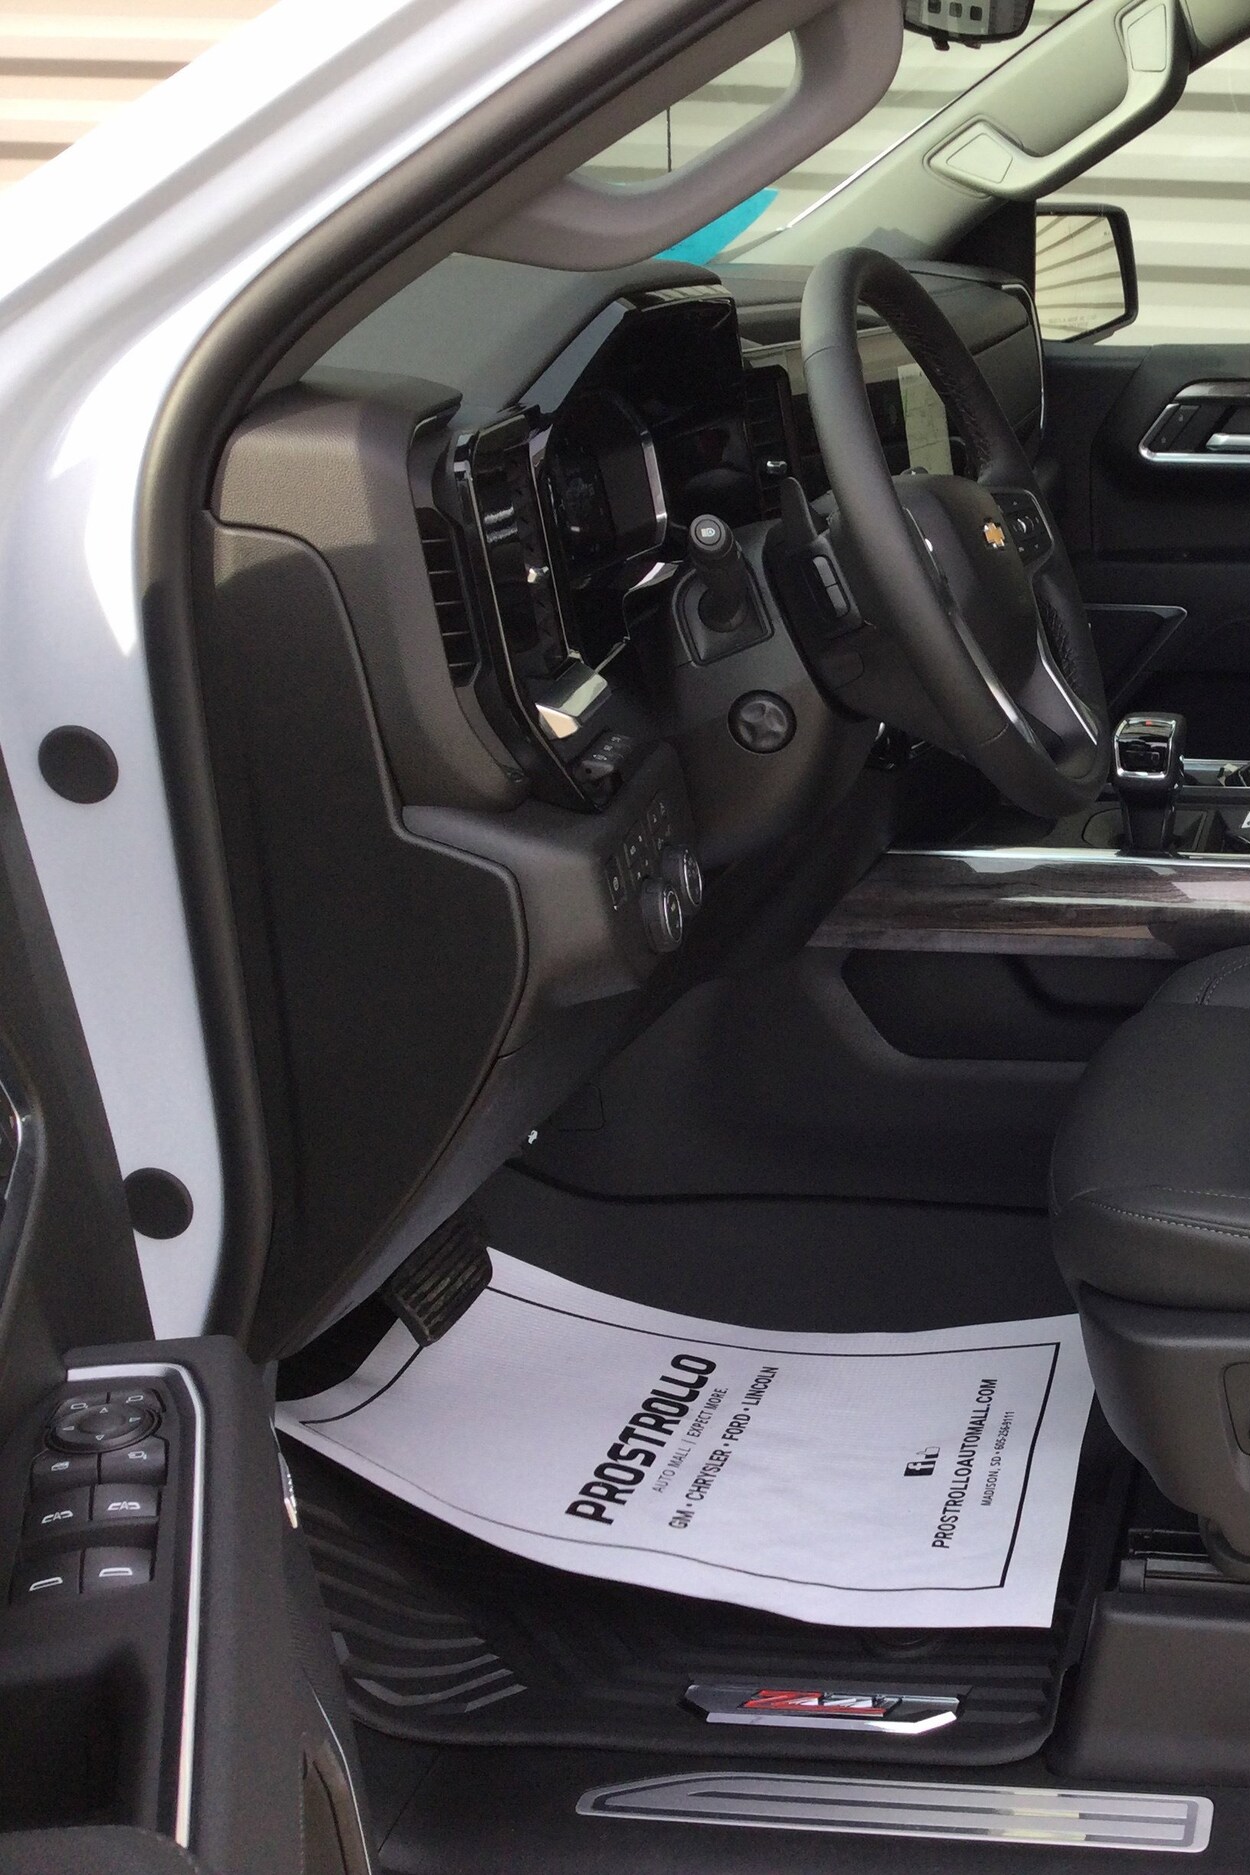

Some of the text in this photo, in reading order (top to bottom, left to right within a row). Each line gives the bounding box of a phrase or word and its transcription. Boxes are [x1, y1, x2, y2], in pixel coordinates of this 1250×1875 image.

[565, 1354, 717, 1525] PROSTROLLO
[652, 1469, 676, 1493] AUTO
[667, 1447, 692, 1469] MALL
[686, 1410, 713, 1438] EXPECT
[668, 1366, 779, 1529] GM CHRYSLER FORD LINCOLN
[931, 1379, 998, 1549] PROSTROLLOAUTOMALL.COM
[990, 1455, 1002, 1467] SD
